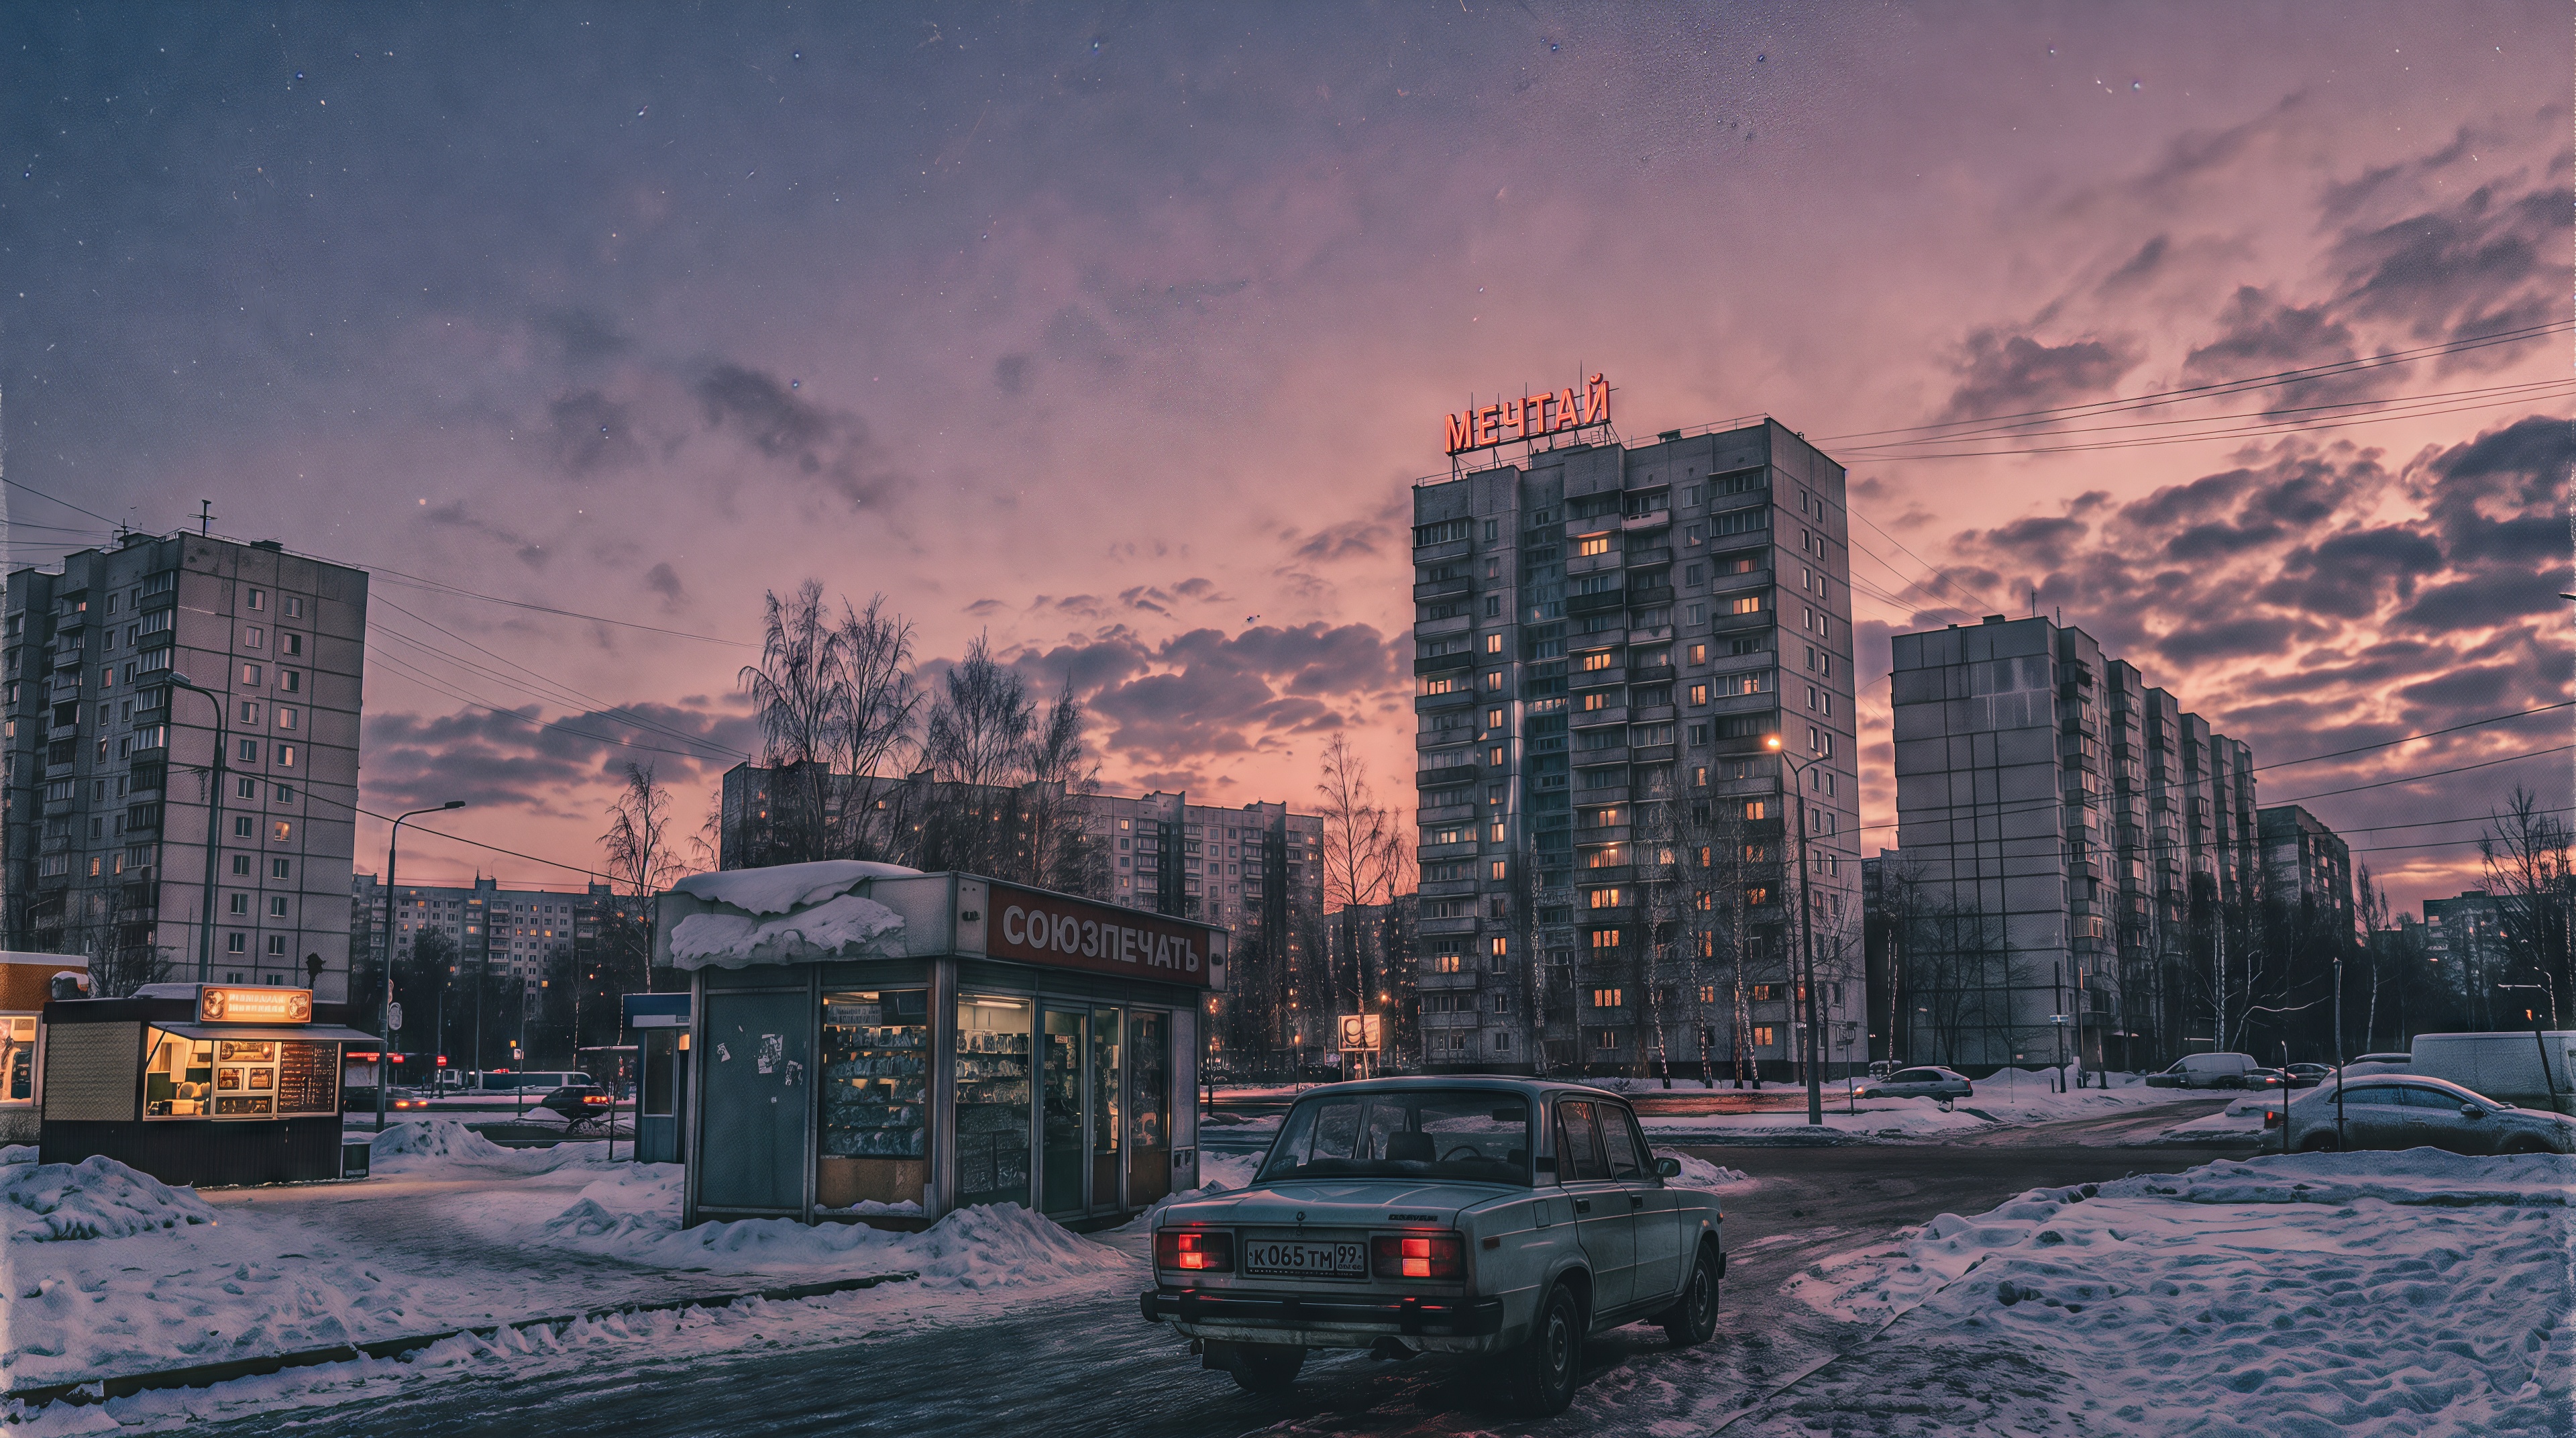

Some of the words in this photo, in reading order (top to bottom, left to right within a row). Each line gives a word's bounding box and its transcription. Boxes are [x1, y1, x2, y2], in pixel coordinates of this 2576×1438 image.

[1445, 372, 1610, 456] МЕЧТАЙ
[1003, 905, 1199, 973] СОЮЗПЕЧАТЬ
[1337, 1245, 1356, 1264] 99
